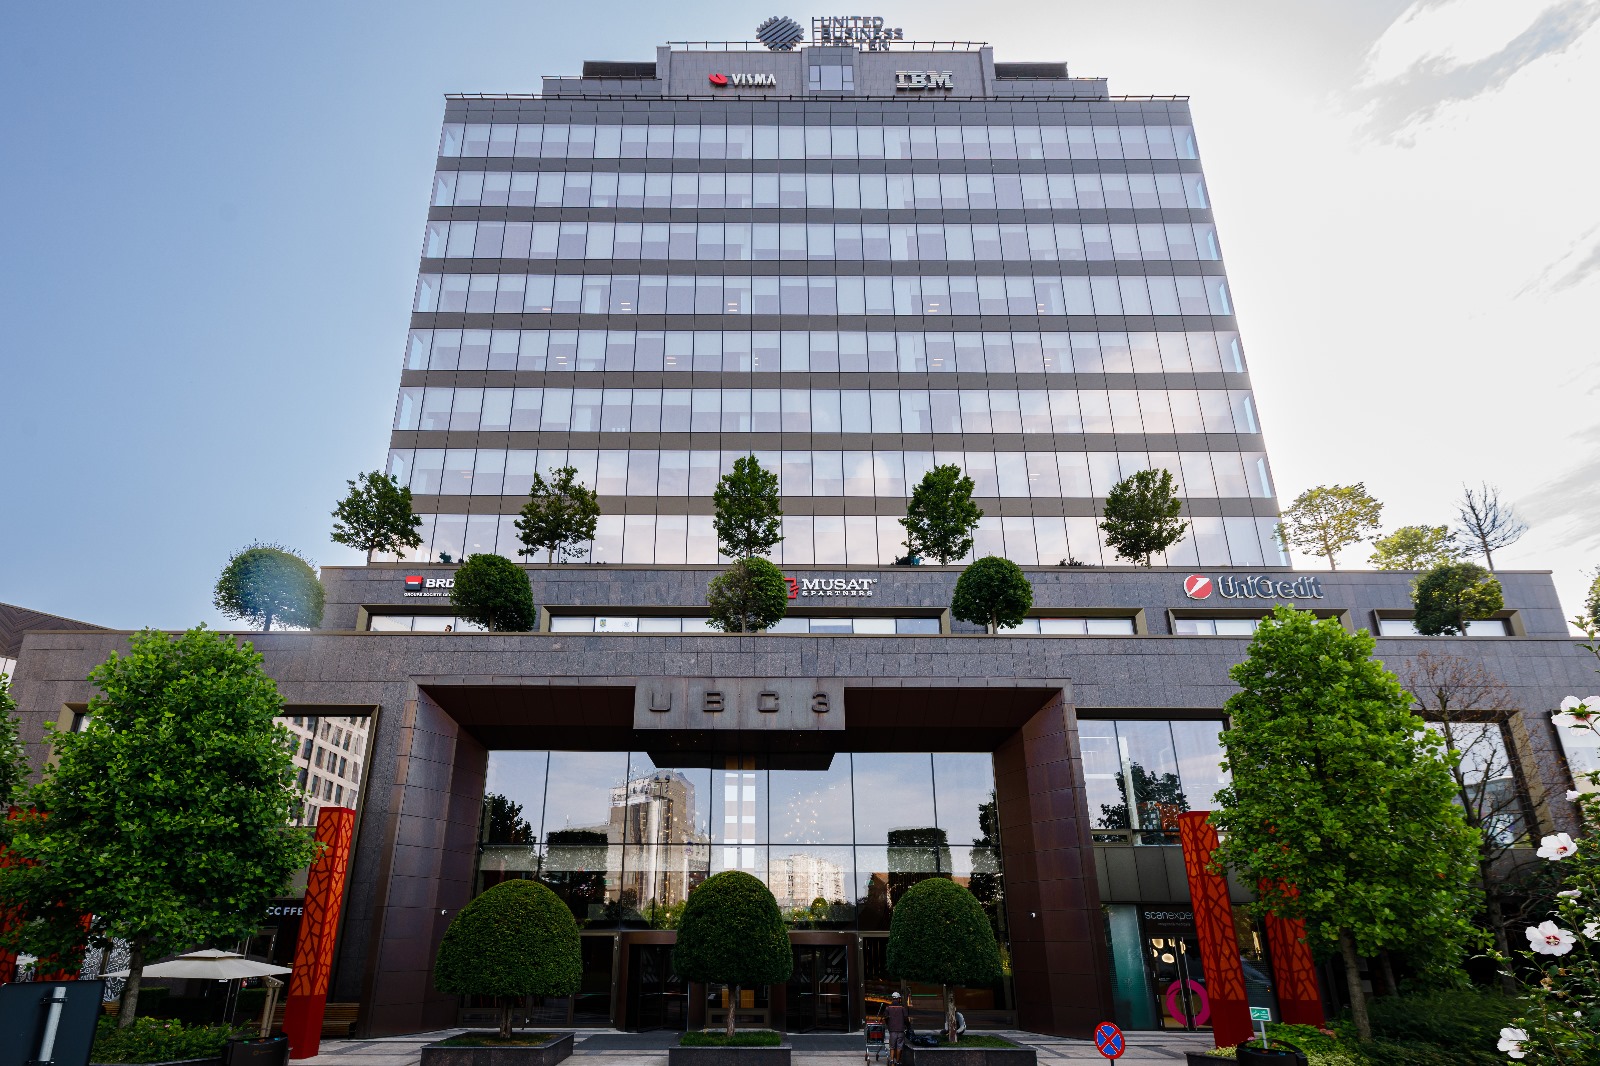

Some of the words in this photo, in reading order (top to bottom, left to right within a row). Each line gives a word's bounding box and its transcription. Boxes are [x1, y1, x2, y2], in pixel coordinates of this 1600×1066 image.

[820, 16, 884, 29] UNITED
[821, 27, 903, 41] BUSINESS
[731, 73, 776, 86] VISMA
[895, 70, 953, 88] IBM
[1218, 575, 1324, 599] UniCredit
